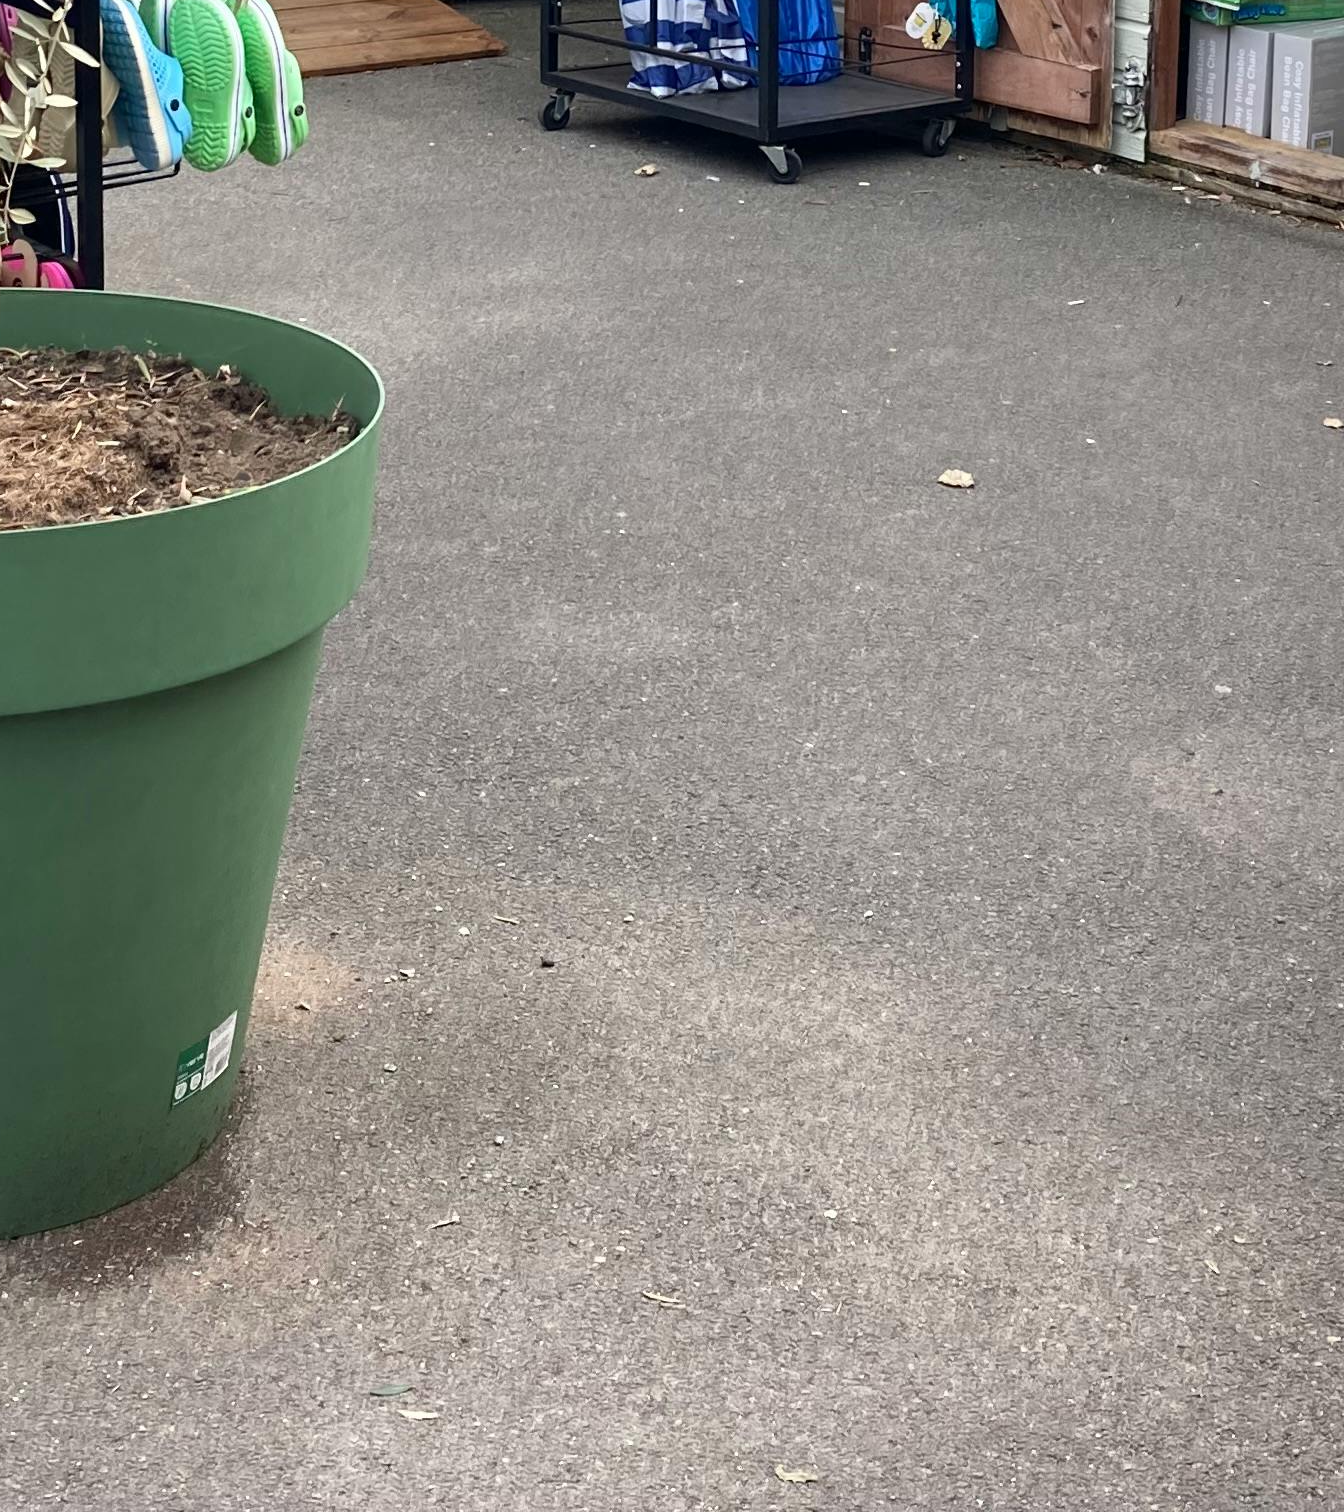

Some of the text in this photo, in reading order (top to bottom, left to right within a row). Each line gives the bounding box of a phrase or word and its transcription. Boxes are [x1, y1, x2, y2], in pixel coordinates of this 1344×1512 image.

[1283, 56, 1293, 86] Bean
[1293, 60, 1304, 89] Cosy
[1234, 48, 1246, 129] osy Inflatable
[1244, 48, 1257, 135] ean Bag Chair
[1281, 90, 1292, 113] Bag
